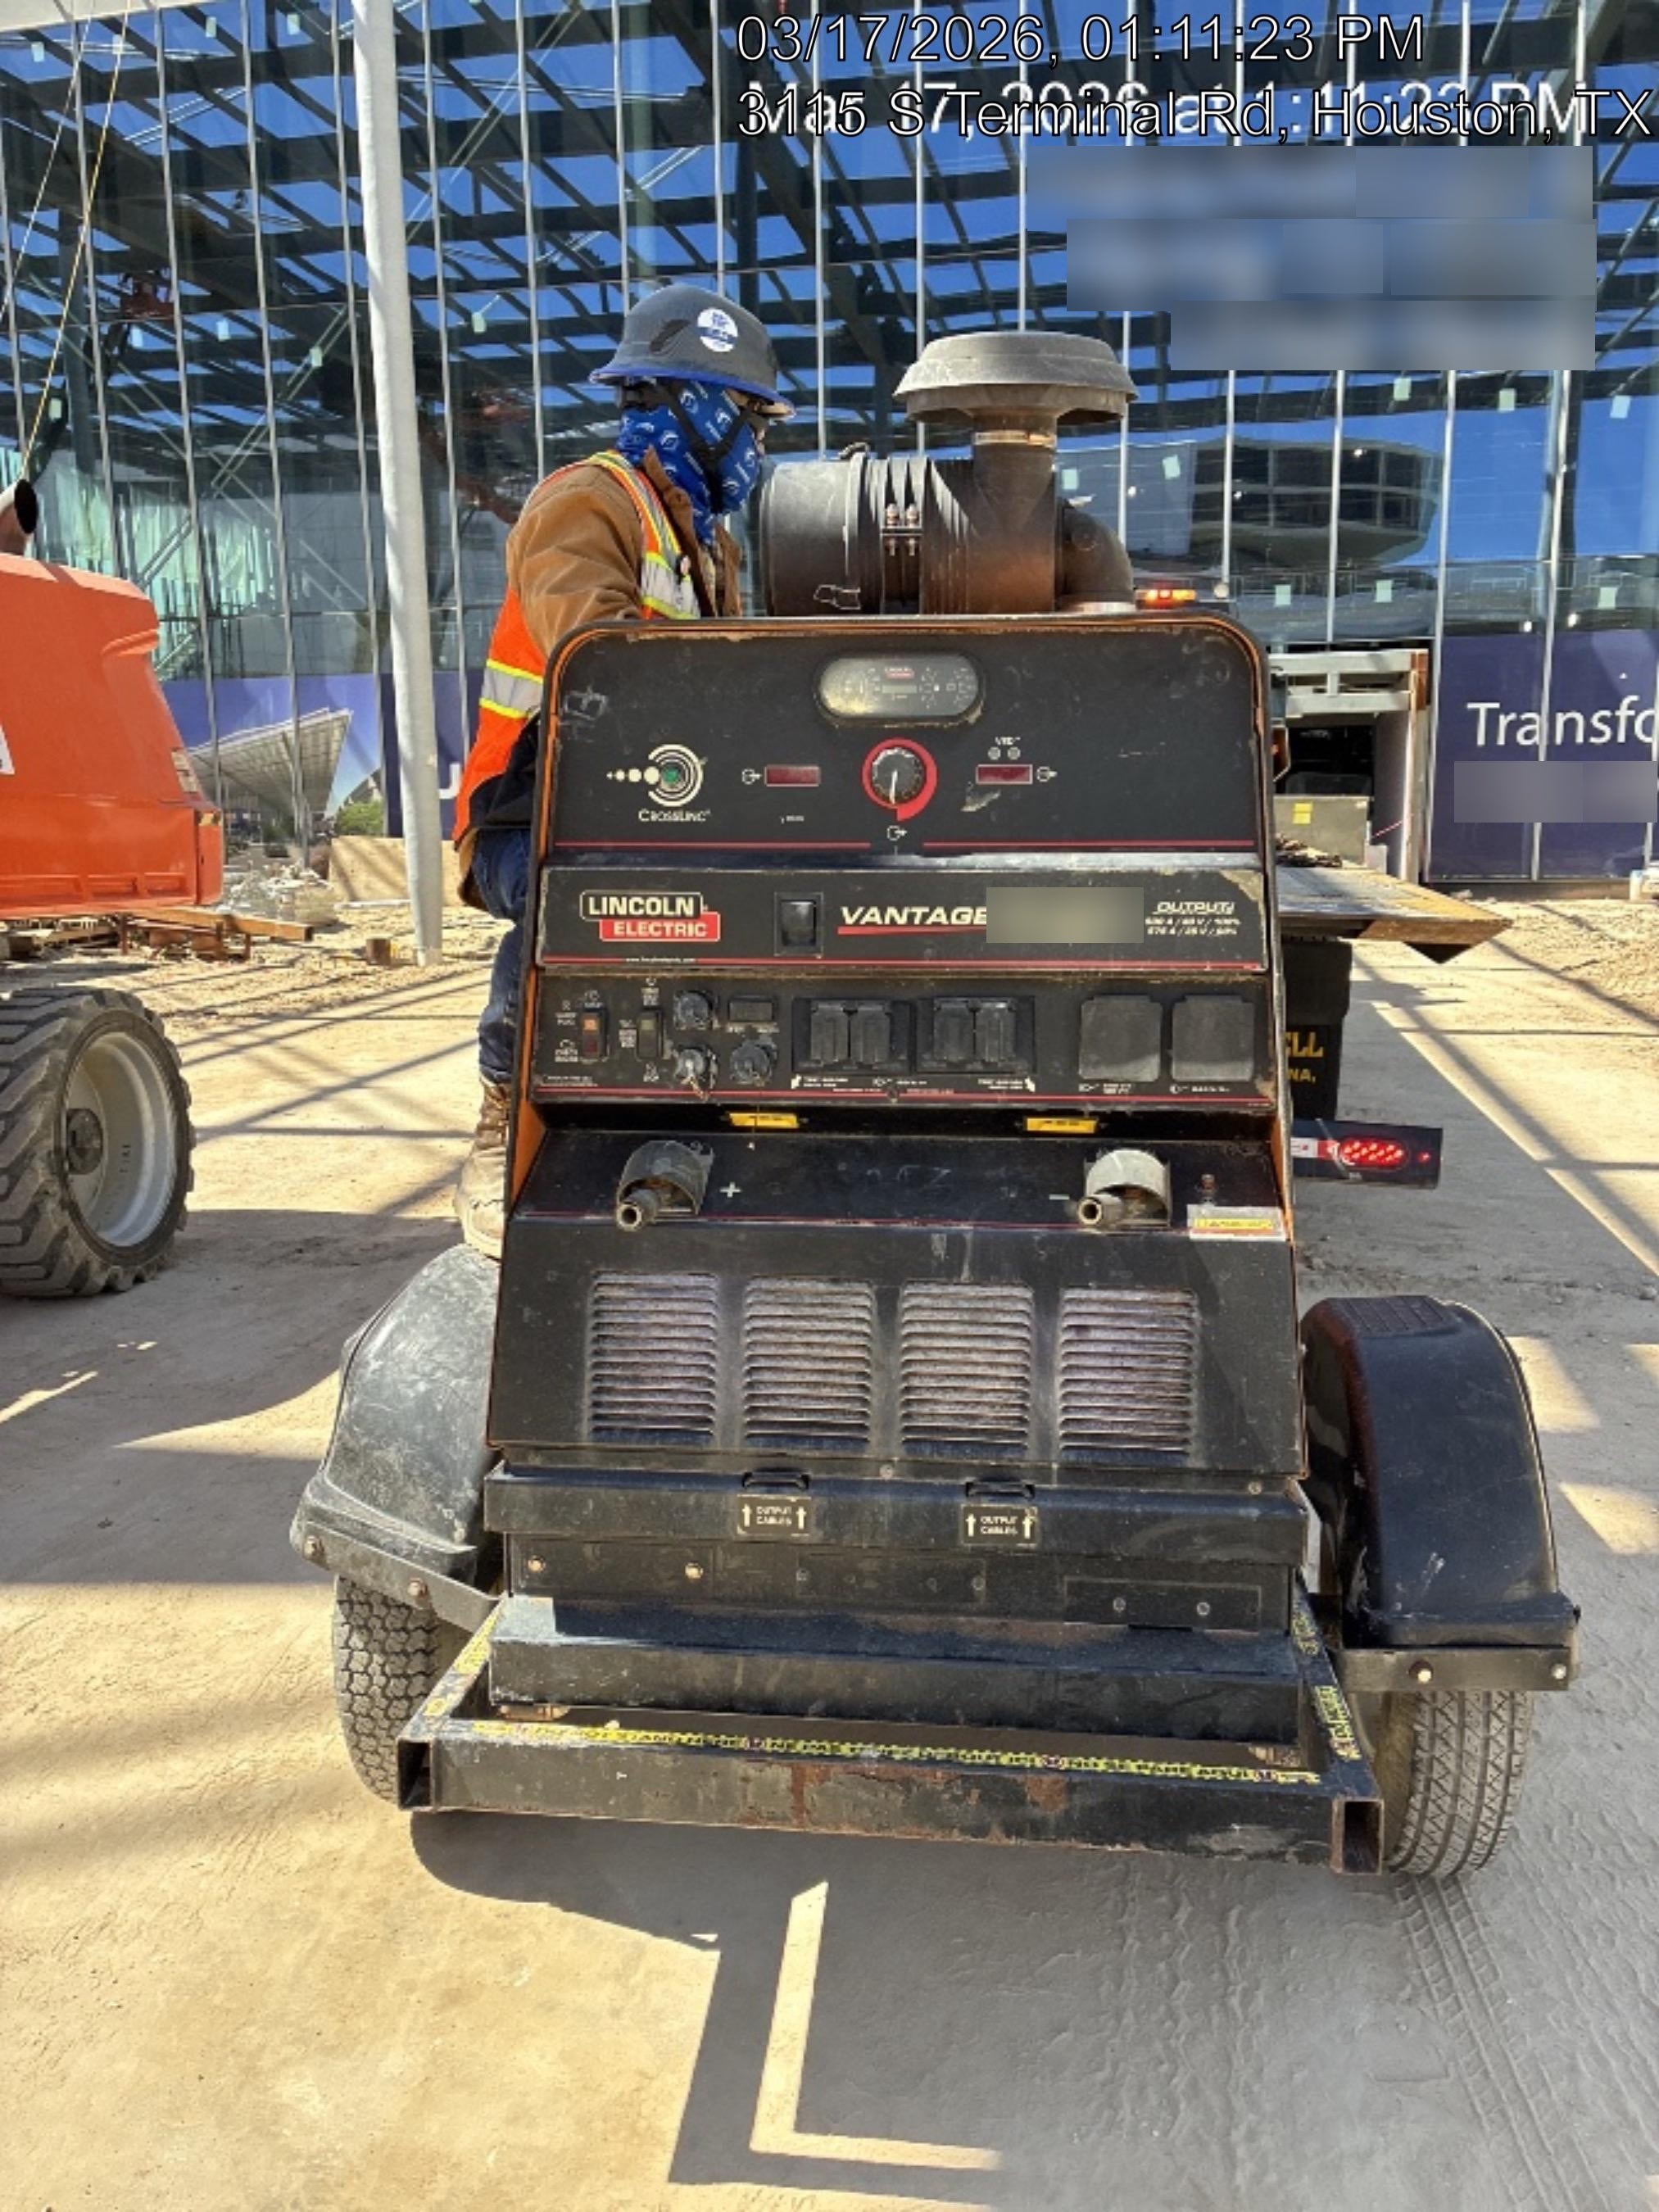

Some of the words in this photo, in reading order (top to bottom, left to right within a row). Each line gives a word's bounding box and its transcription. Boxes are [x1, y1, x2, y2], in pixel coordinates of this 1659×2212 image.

[588, 895, 694, 917] LINCOLN
[840, 905, 986, 925] VANTAGE
[614, 922, 708, 937] ELECTRIC
